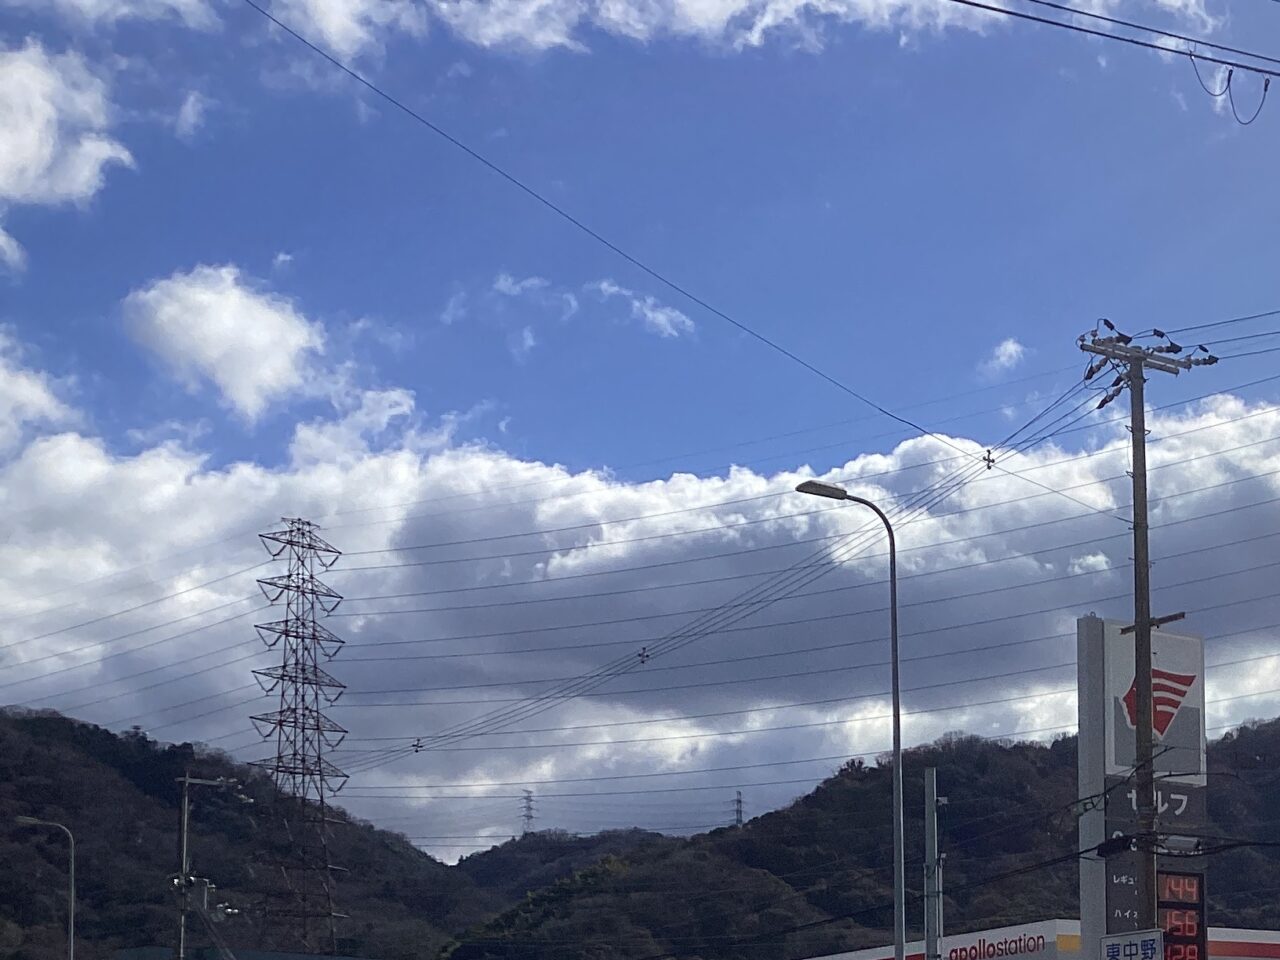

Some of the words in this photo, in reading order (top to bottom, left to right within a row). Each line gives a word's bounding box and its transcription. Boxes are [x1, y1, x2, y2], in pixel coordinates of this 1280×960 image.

[1113, 874, 1137, 885] レギュ
[1165, 877, 1198, 901] 144
